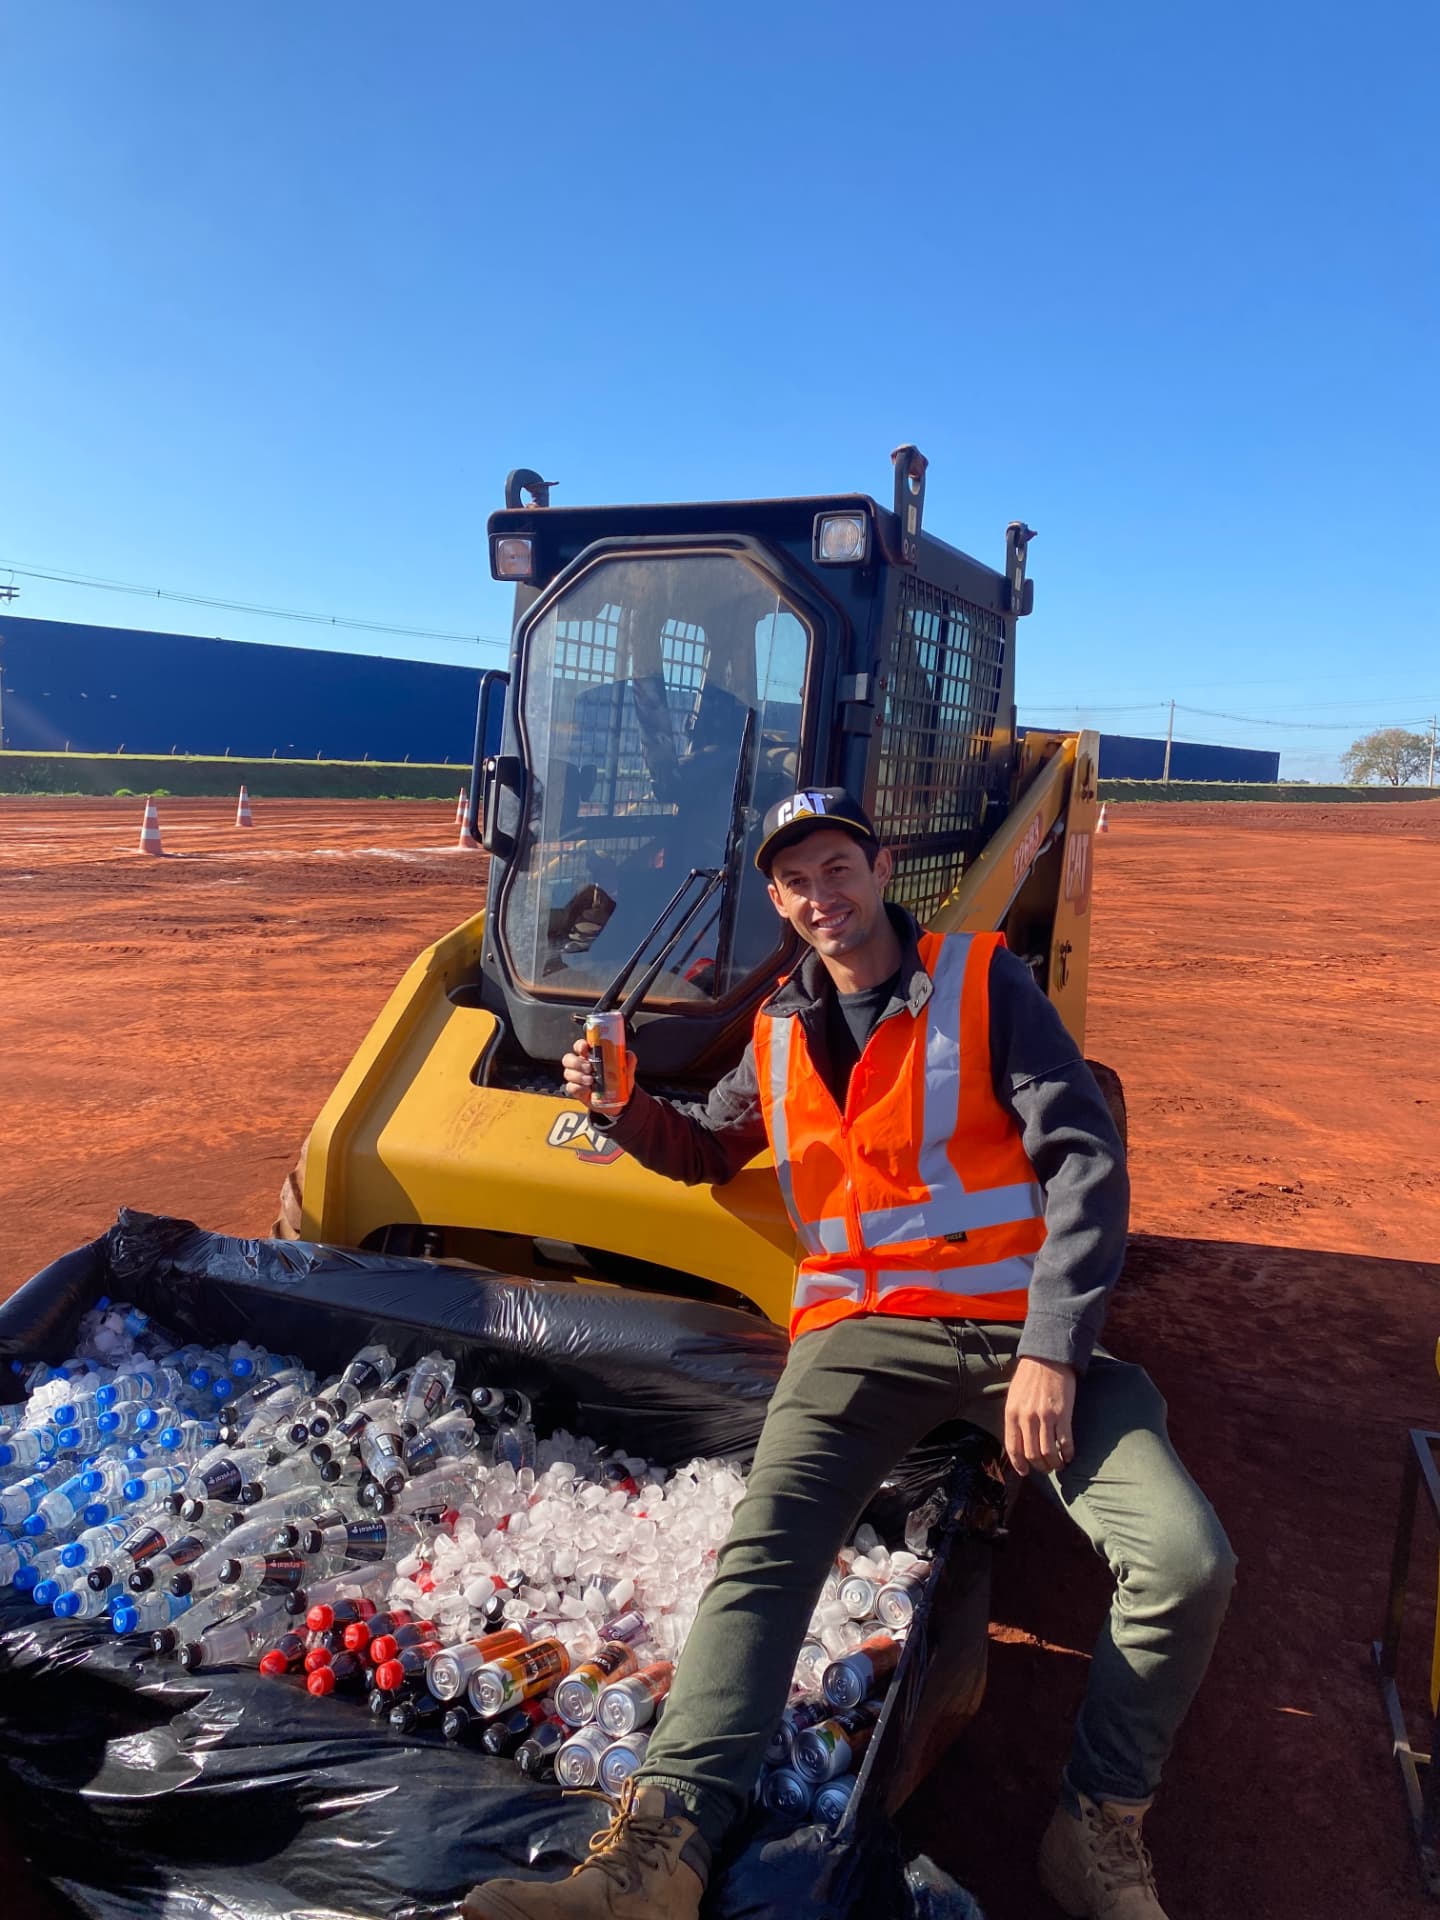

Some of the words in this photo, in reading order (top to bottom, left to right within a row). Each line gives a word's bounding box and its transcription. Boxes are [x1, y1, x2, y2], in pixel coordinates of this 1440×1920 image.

[777, 792, 827, 827] CAT
[1066, 833, 1089, 898] CAT
[359, 1524, 383, 1535] crystal
[277, 1561, 301, 1569] crystal
